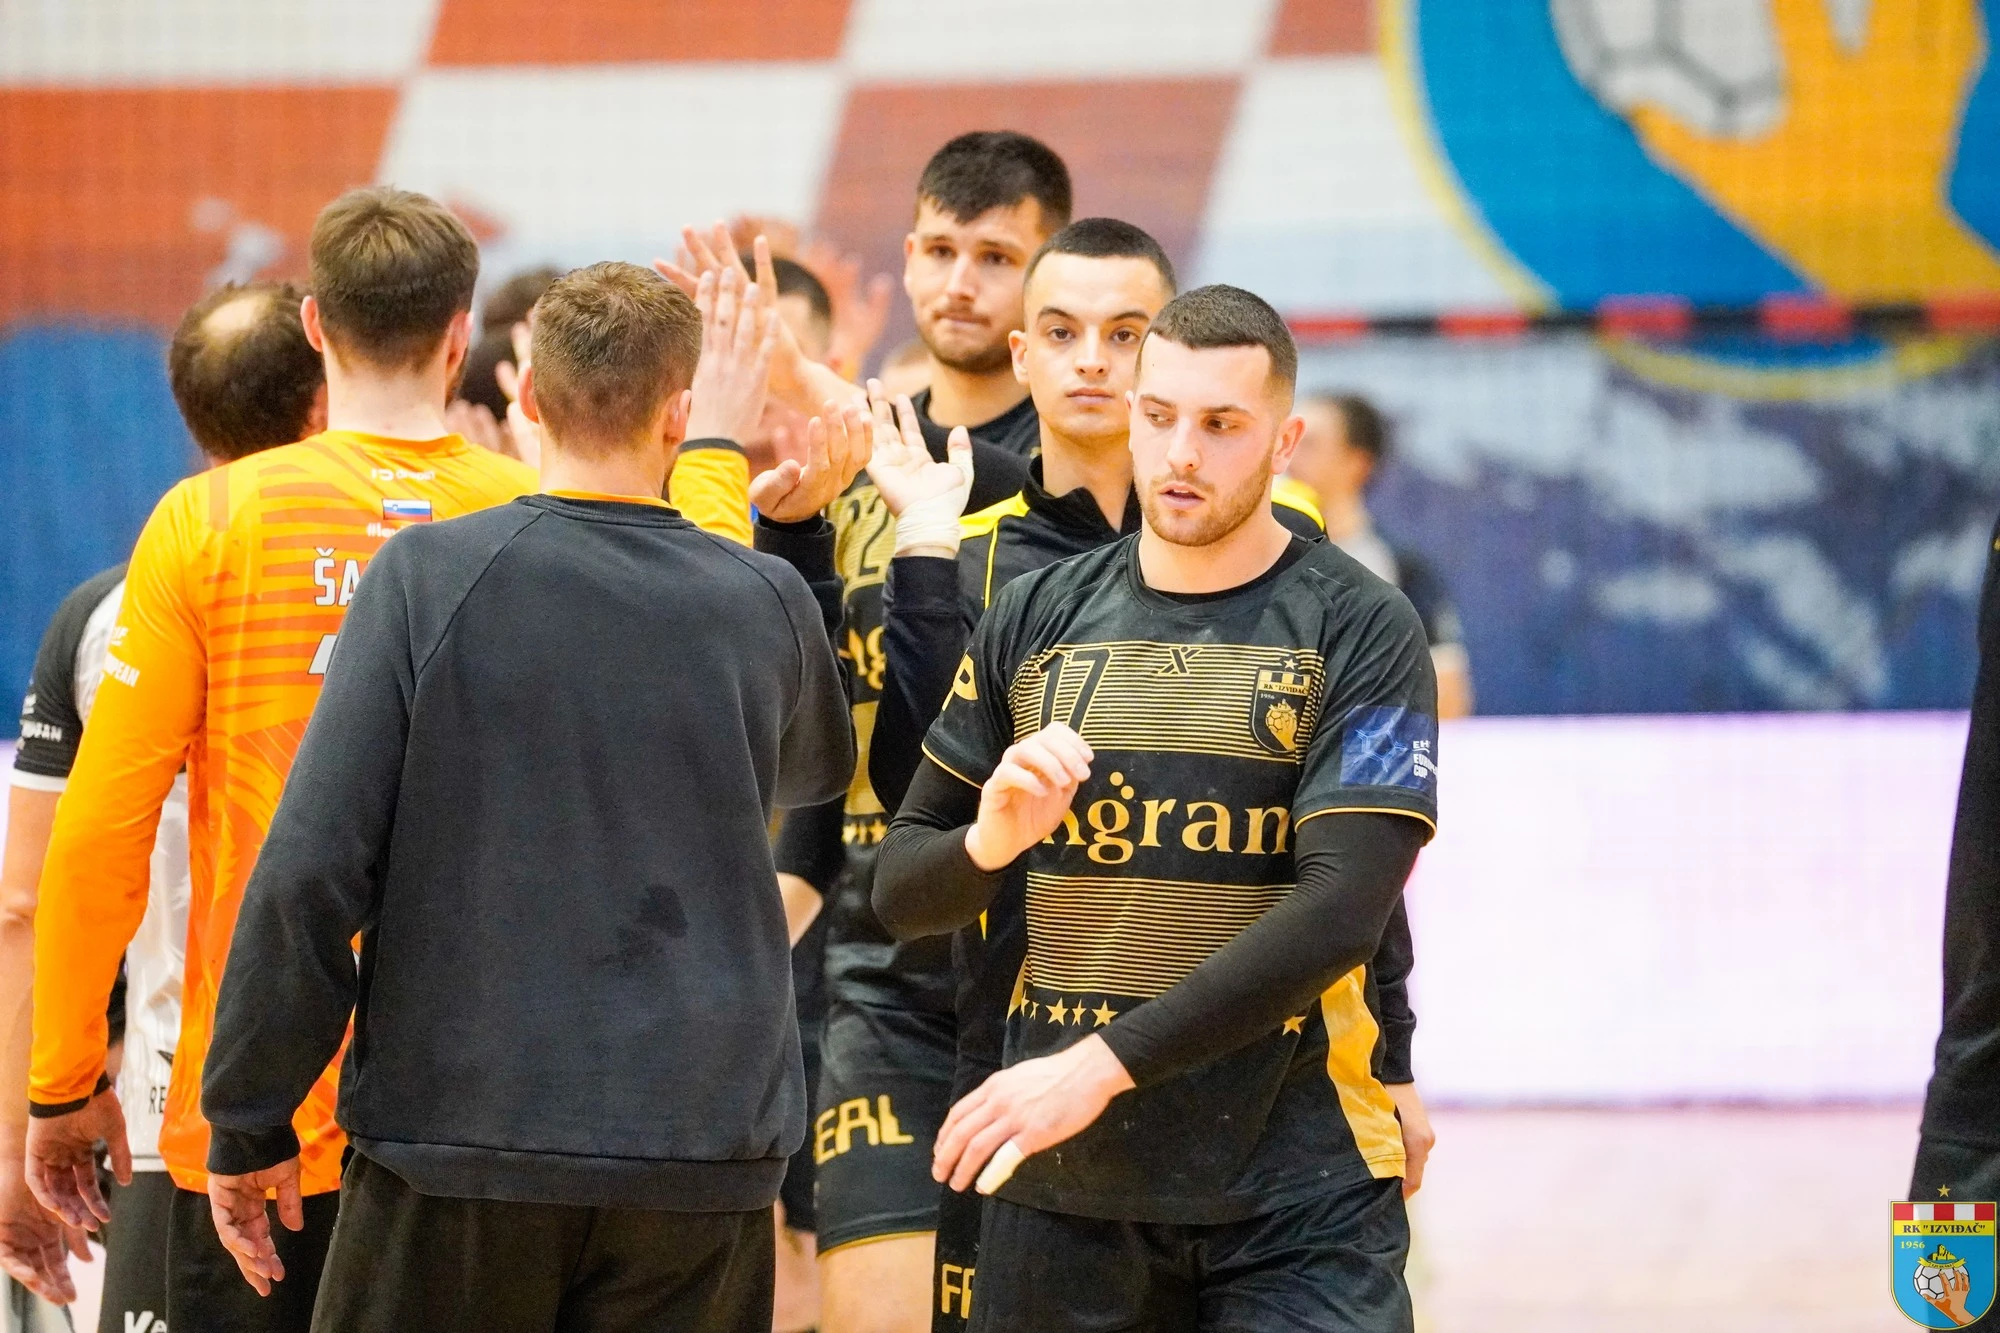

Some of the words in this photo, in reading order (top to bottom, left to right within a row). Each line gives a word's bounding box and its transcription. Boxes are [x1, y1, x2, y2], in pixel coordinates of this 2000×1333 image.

[313, 546, 360, 606] ŠA
[1037, 648, 1113, 736] 17
[149, 1085, 167, 1114] RE
[814, 1095, 914, 1165] EAL
[124, 1310, 168, 1333] Ke
